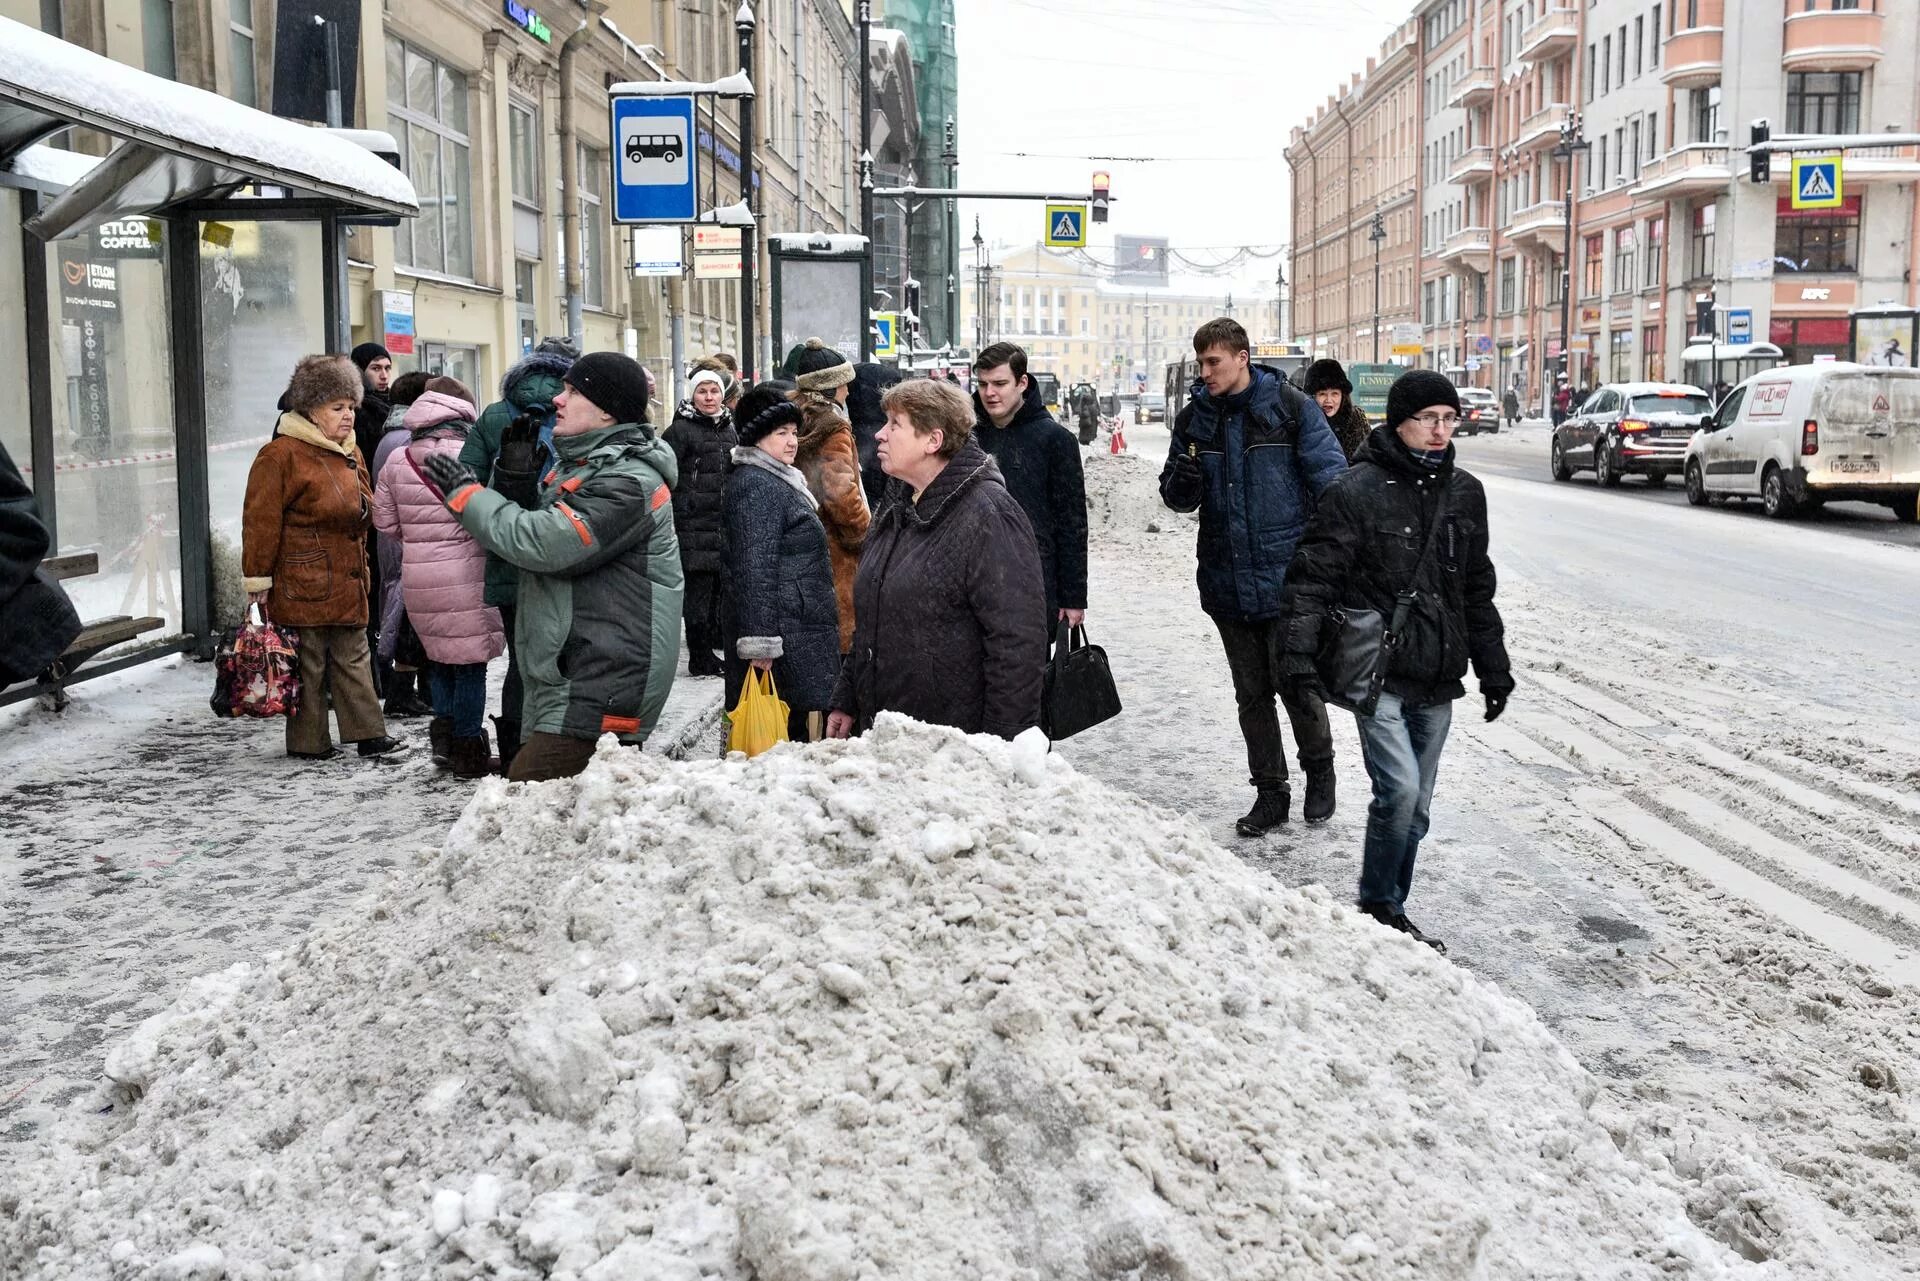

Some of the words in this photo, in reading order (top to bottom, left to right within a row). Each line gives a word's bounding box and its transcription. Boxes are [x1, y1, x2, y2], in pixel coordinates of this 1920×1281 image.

[100, 221, 149, 236] ETLON
[100, 237, 152, 249] COFFEE
[90, 264, 115, 279] ETLON
[92, 278, 117, 291] COFFEE
[1801, 288, 1830, 300] KFC
